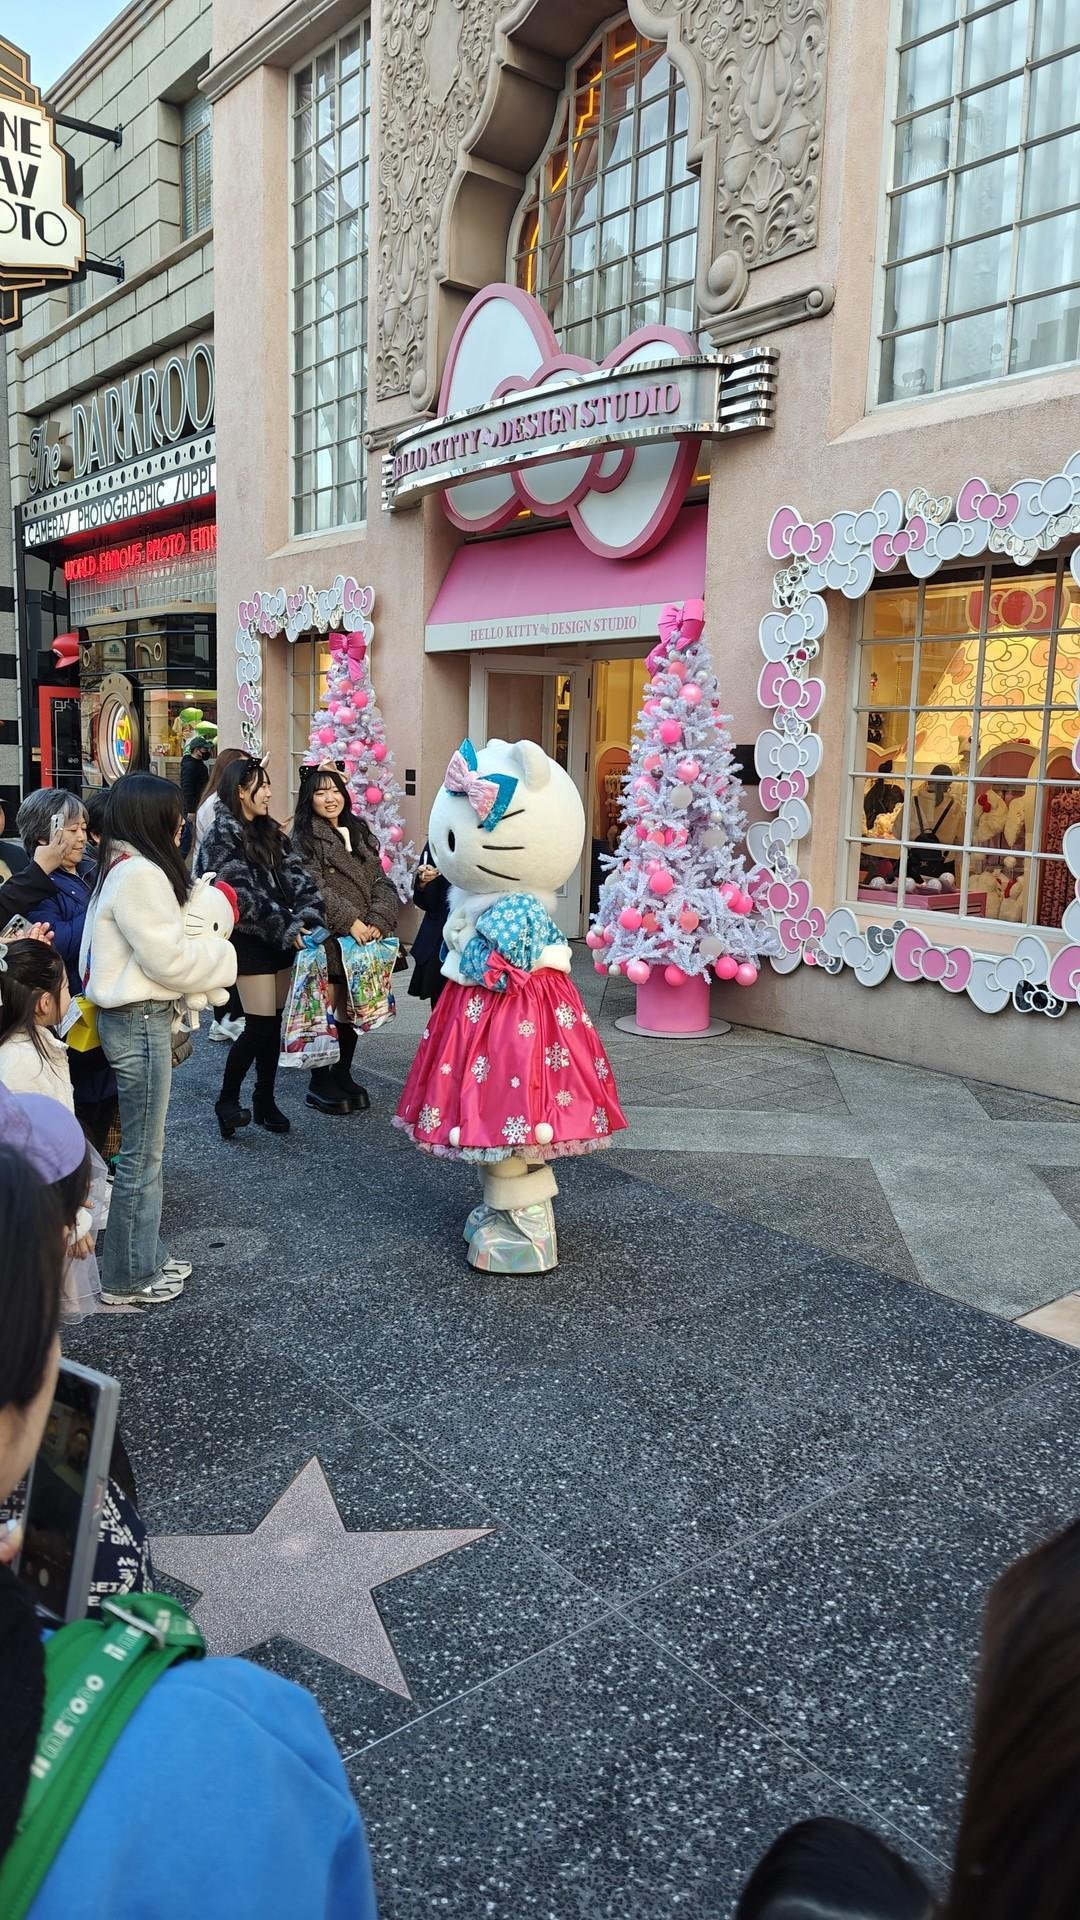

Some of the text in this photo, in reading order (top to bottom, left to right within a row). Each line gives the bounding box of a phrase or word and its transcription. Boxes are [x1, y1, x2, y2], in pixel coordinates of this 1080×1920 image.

[0, 111, 41, 158] NE
[28, 420, 61, 495] The
[392, 383, 681, 481] HELLO KITTY DESIGN STUDIO
[27, 511, 72, 545] CAMERAS
[78, 482, 165, 526] PHOTOGRAPHIC
[64, 556, 97, 581] WORLD
[99, 542, 143, 573] FAMOUS
[146, 532, 186, 563] PHOTO
[470, 615, 637, 642] HELLO KITTY DESIGN STUDIO
